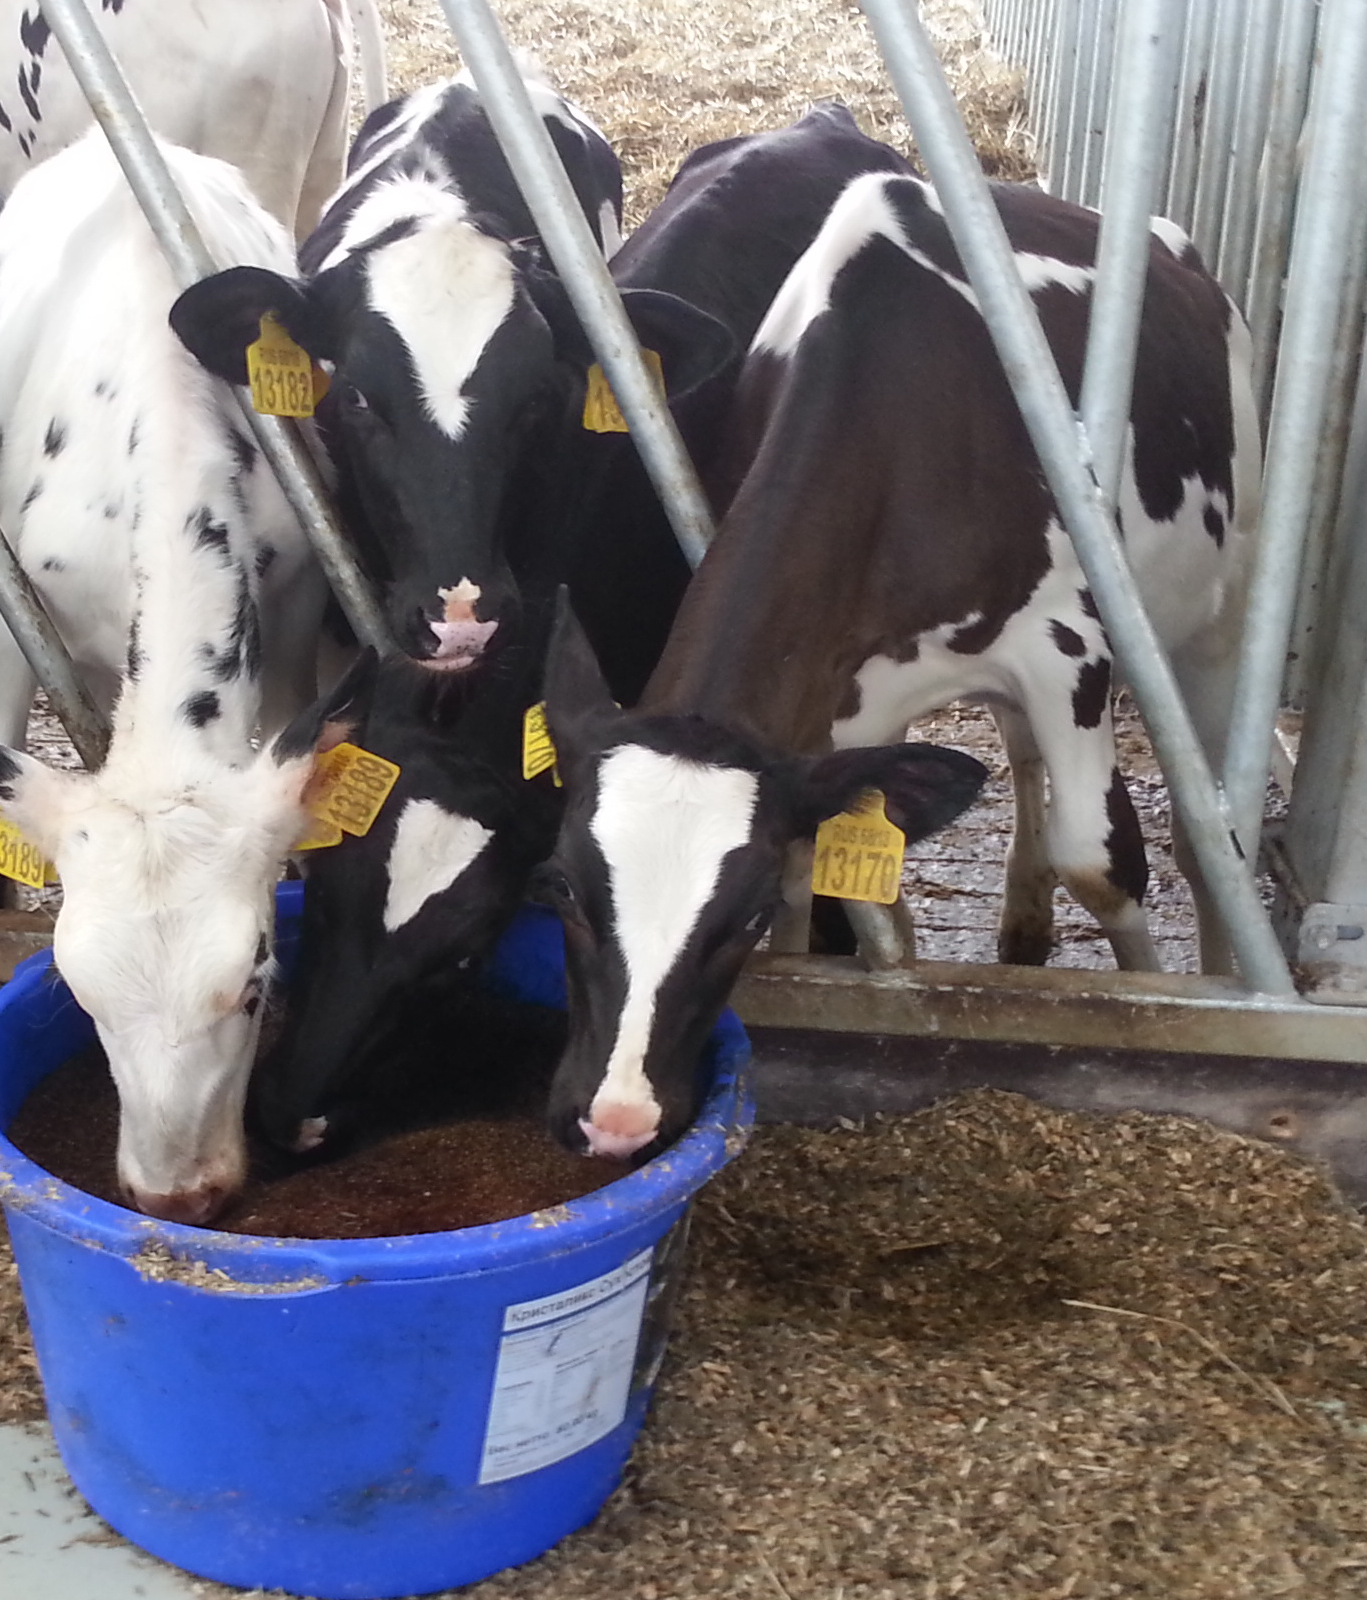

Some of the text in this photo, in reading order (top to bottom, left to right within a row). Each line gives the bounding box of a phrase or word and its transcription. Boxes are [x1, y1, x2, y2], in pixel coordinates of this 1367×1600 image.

[254, 367, 312, 412] 13182
[328, 756, 394, 827] 13189
[819, 845, 896, 898] 13170
